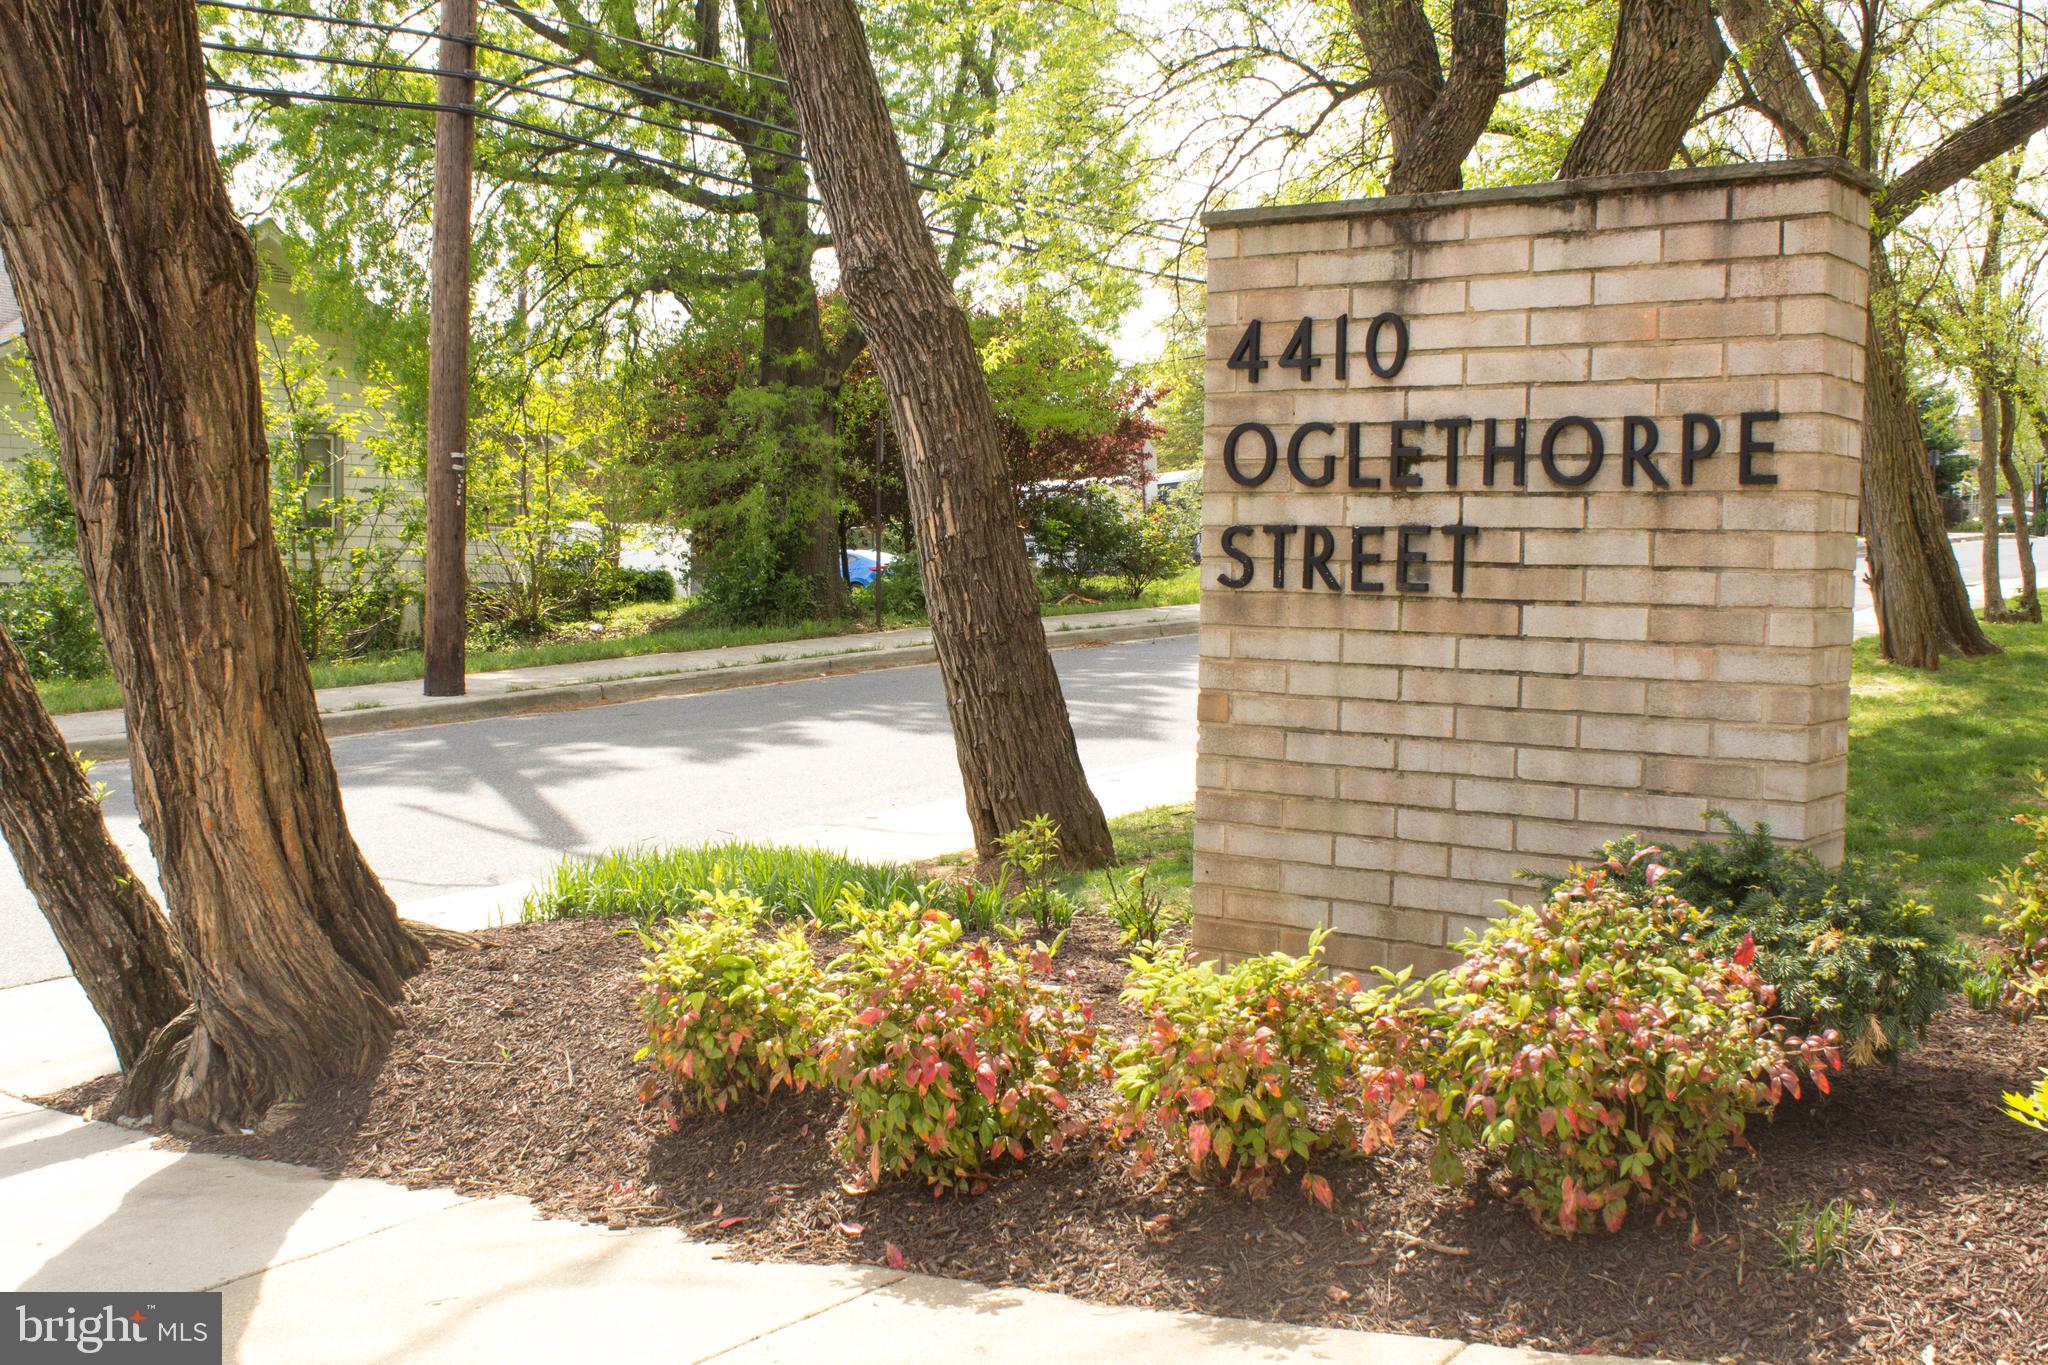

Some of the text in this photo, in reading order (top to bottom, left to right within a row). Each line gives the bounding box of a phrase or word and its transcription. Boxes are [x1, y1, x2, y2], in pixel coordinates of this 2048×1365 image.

[1227, 312, 1410, 383] 4410
[1223, 411, 1780, 487] OGLETHORPE
[1217, 524, 1479, 593] STREET
